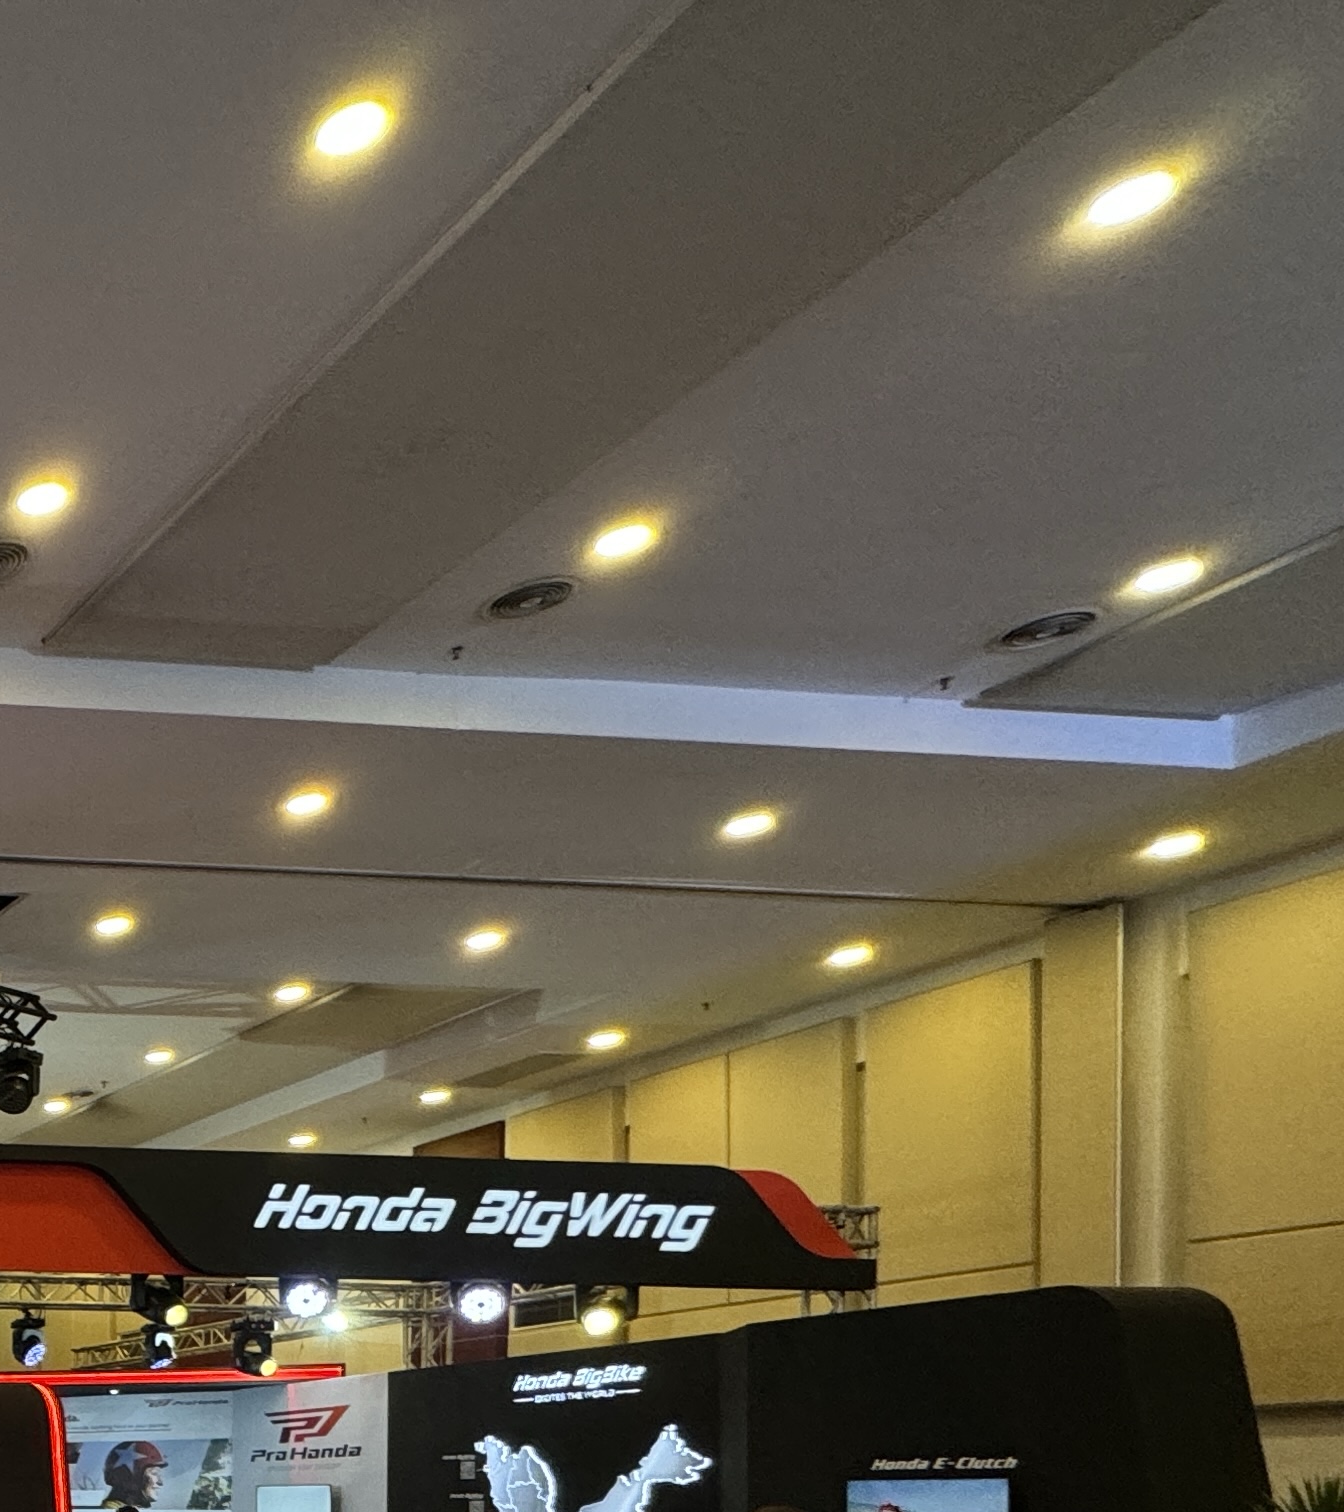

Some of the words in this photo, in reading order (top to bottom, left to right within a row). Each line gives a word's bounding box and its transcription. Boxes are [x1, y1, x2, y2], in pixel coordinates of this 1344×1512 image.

[253, 1183, 456, 1232] Honda
[465, 1189, 716, 1252] BigWing
[512, 1371, 573, 1392] Honda
[572, 1364, 647, 1389] BigBike
[870, 1458, 931, 1471] Honda
[932, 1456, 1018, 1470] E-Clutch
